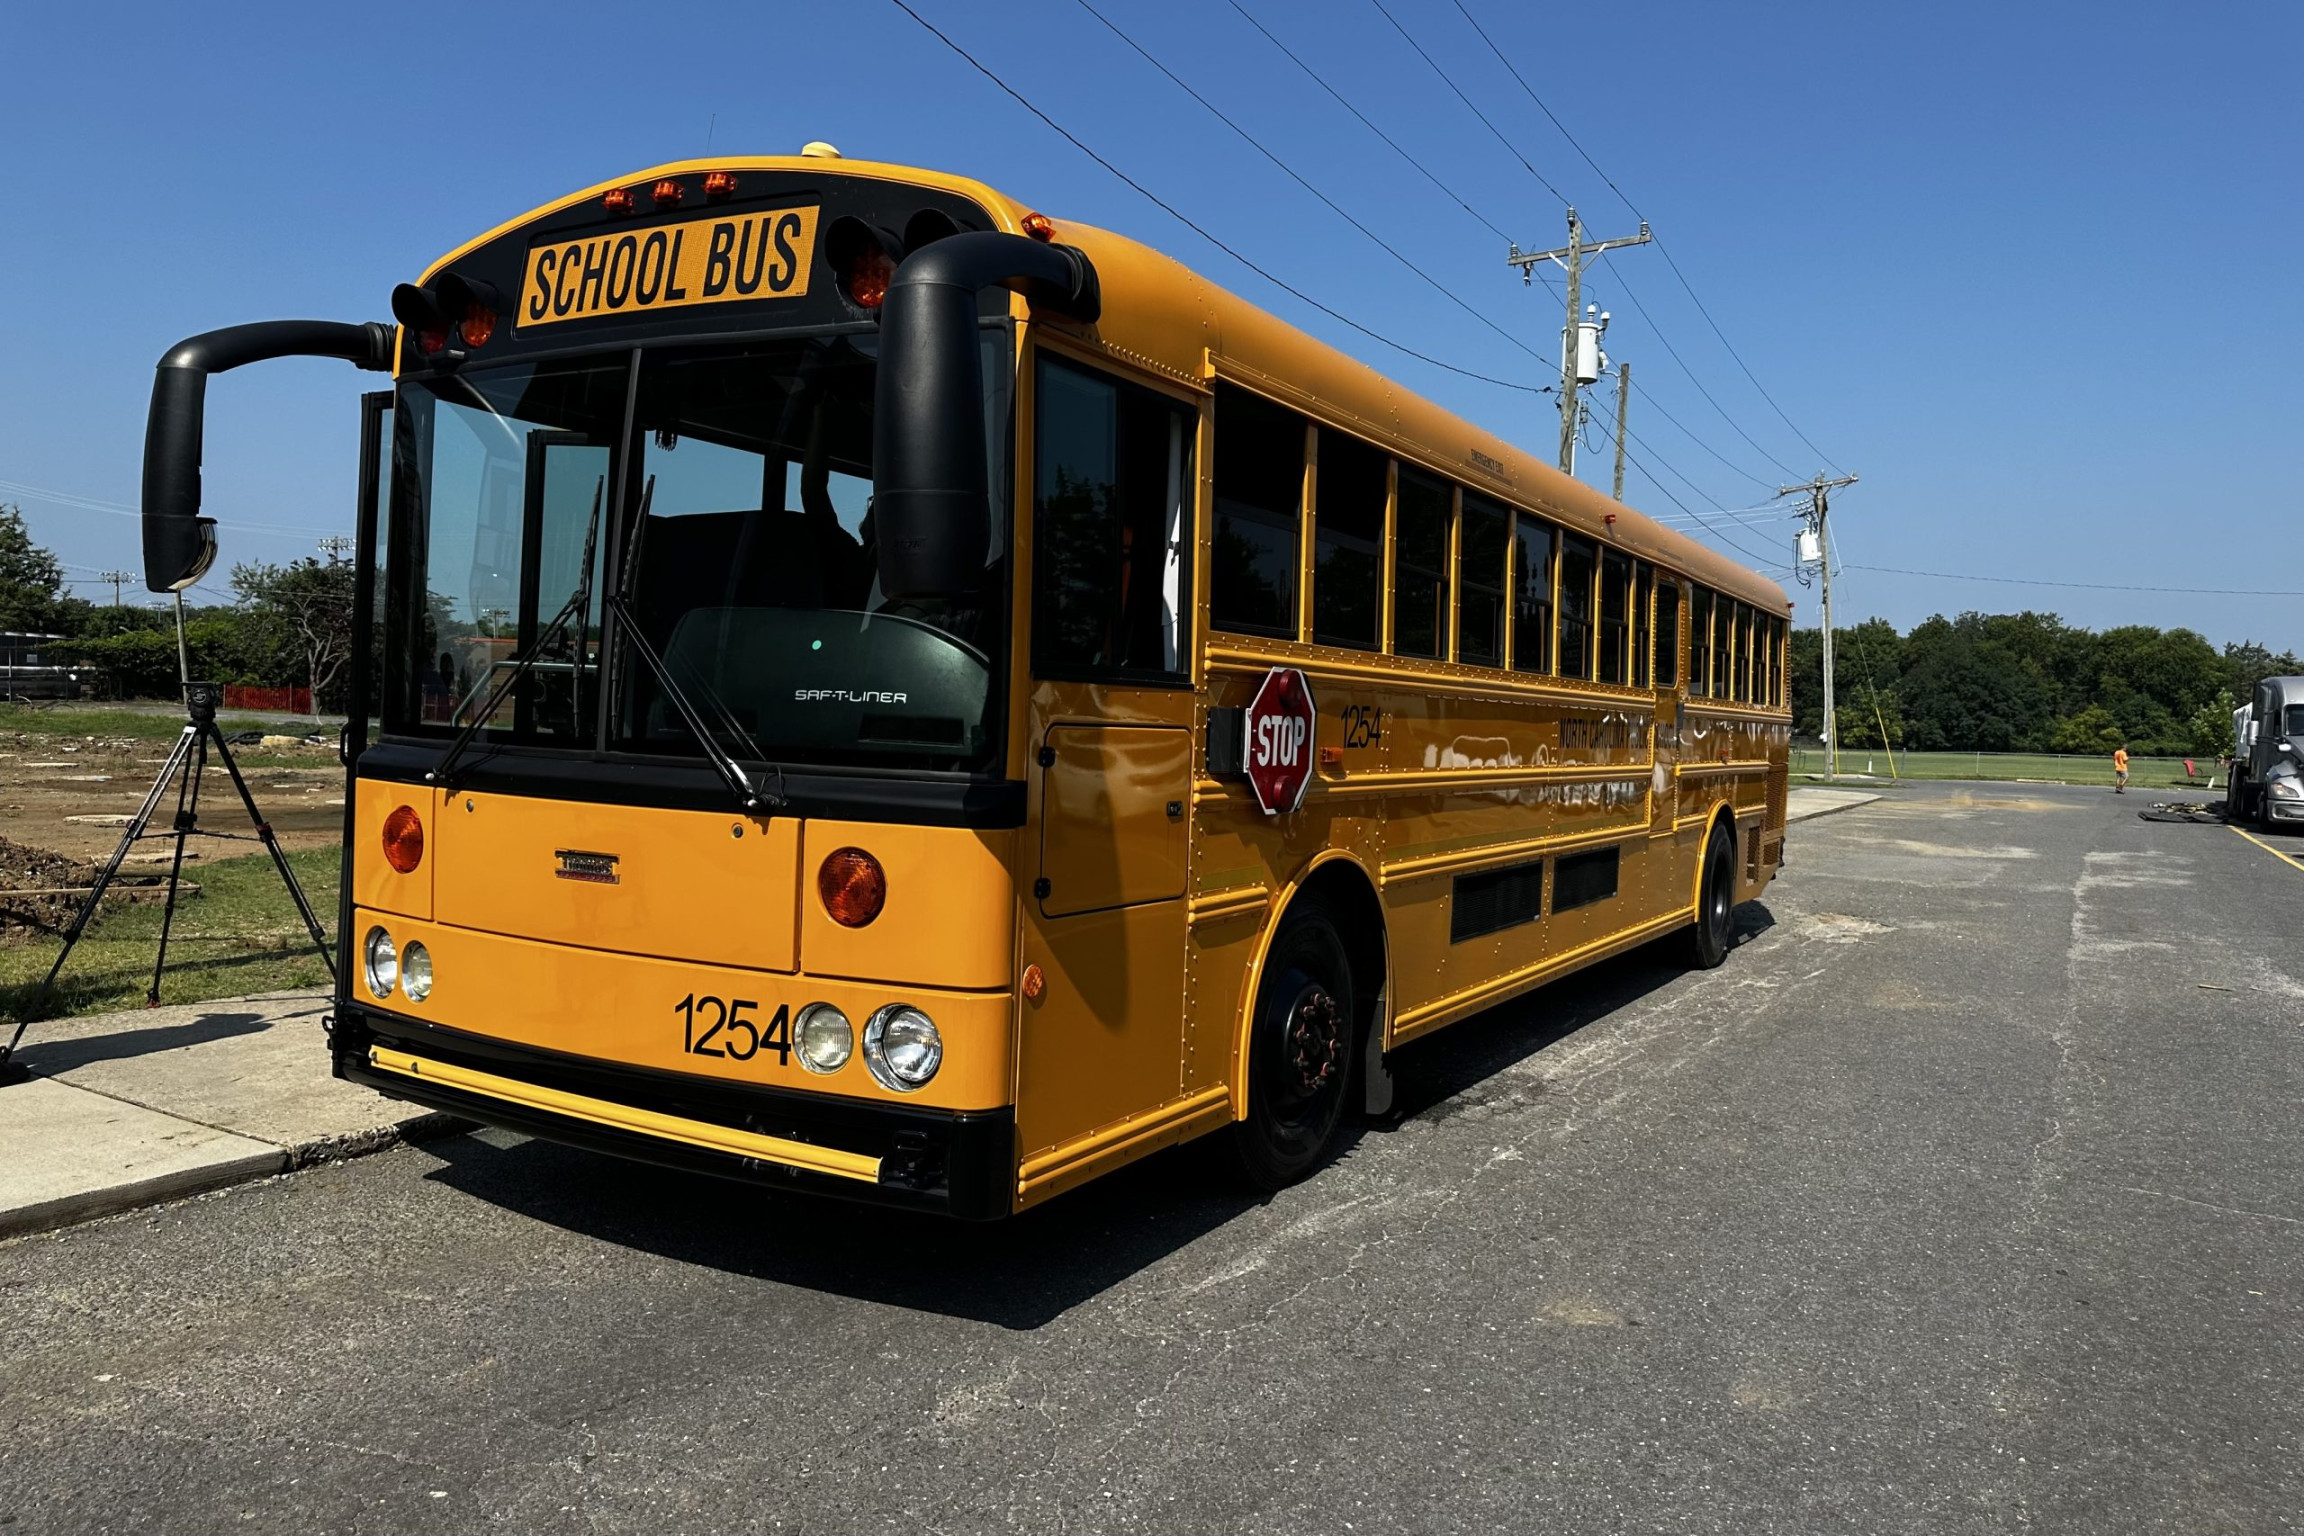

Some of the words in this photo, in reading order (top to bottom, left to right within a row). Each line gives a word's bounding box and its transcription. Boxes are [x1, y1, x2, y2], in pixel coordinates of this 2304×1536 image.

[529, 229, 686, 321] SCHOOL
[702, 213, 802, 297] BUS
[1257, 714, 1306, 767] STOP
[1341, 704, 1381, 749] 1254
[1560, 716, 1587, 749] NORTH
[674, 992, 792, 1067] 1254
